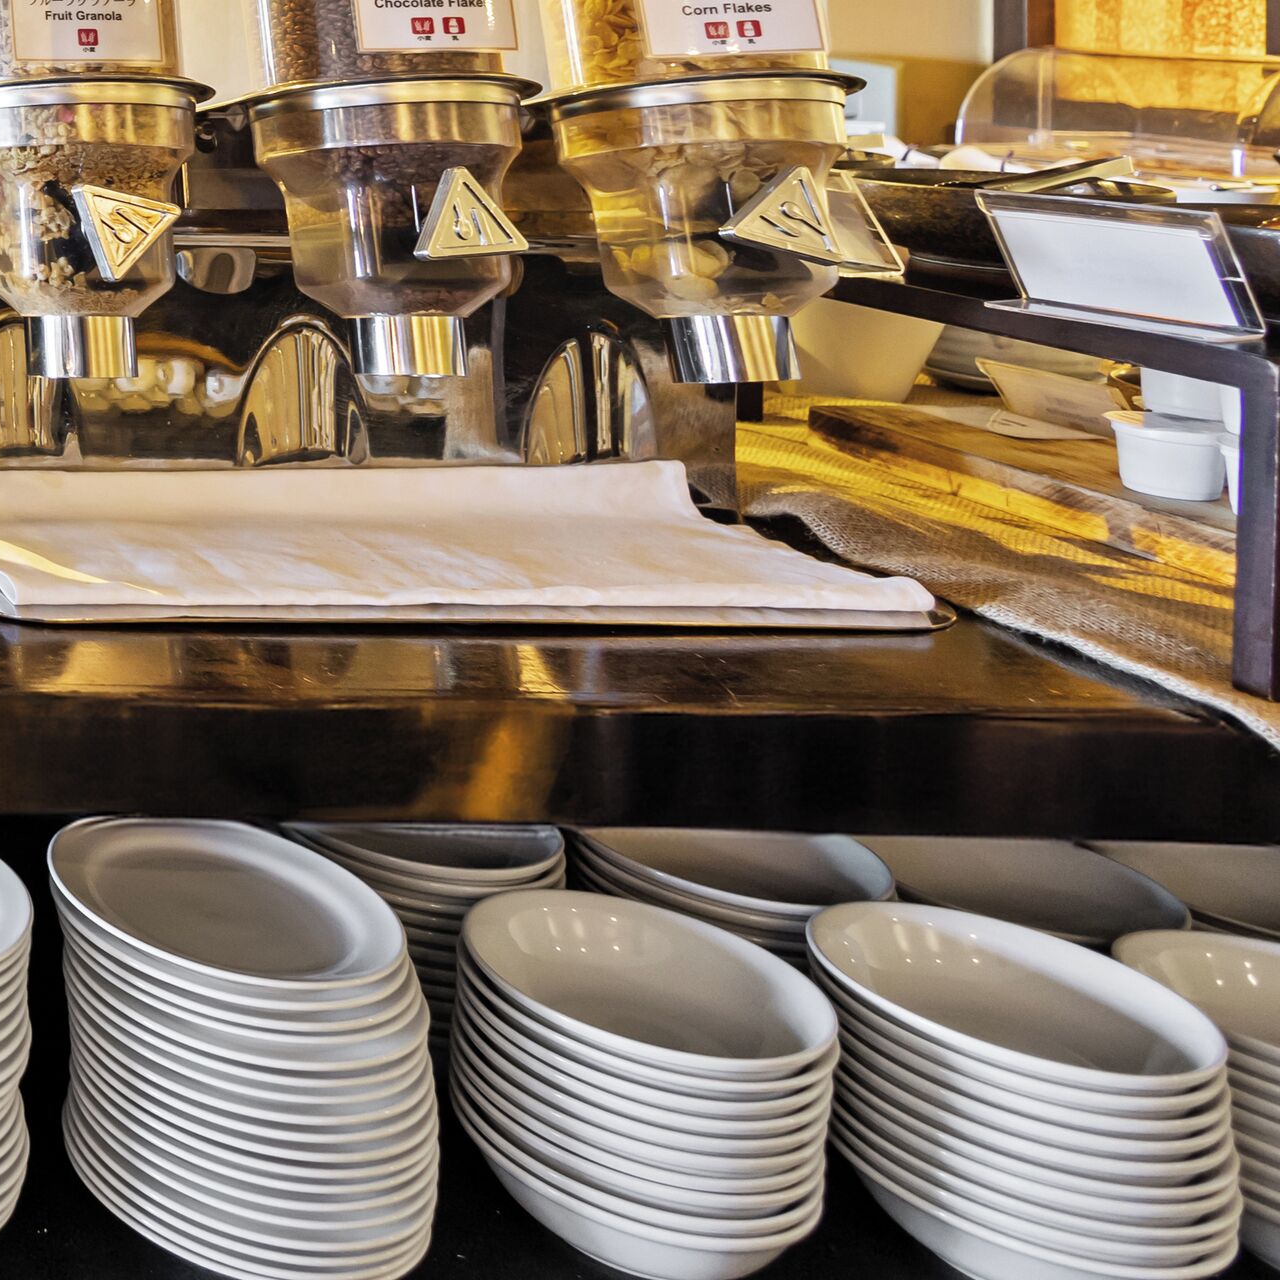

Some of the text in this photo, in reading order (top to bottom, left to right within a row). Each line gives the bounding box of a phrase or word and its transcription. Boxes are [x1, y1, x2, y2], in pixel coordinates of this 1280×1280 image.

[45, 10, 122, 21] Fruit Granola
[682, 2, 772, 17] Corn Flakes
